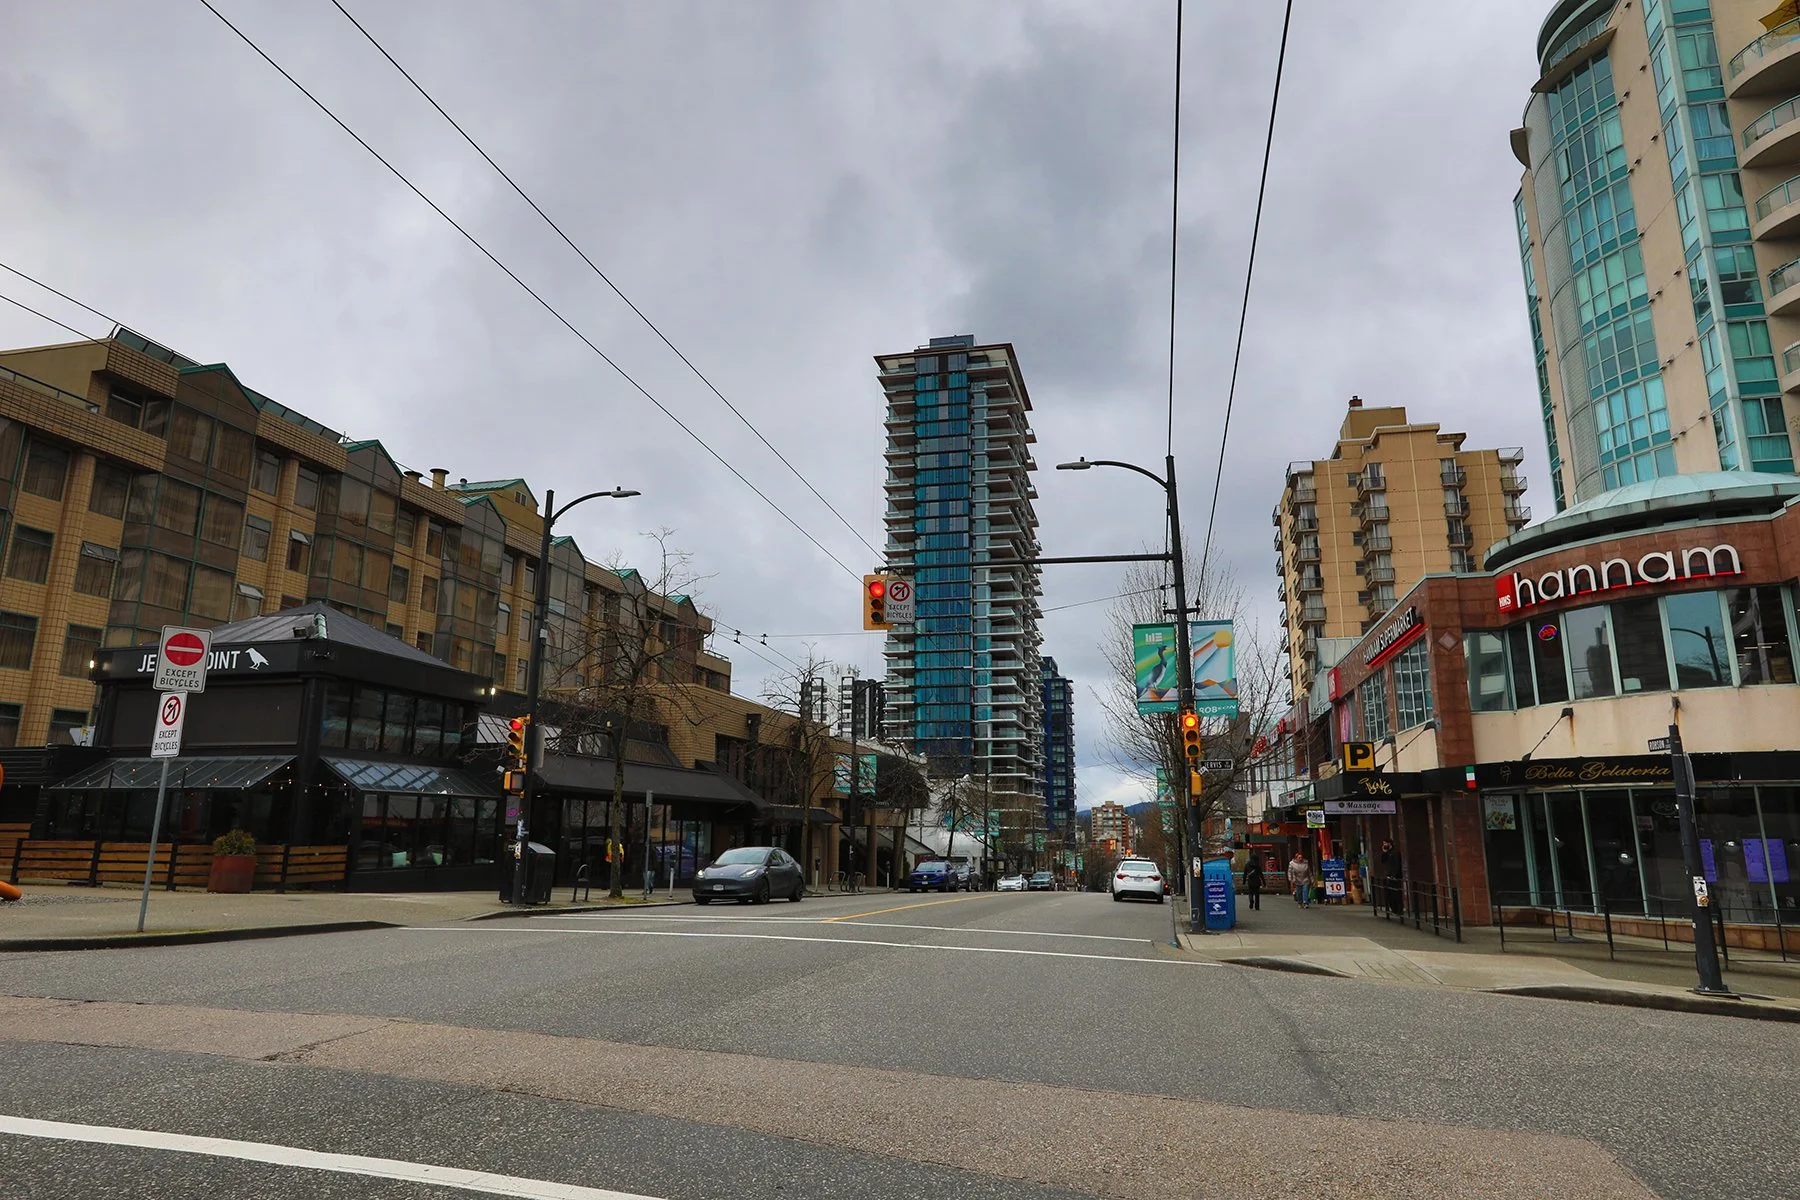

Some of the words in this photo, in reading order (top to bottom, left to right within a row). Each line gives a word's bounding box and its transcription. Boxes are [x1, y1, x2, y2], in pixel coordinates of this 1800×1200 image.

[1513, 544, 1742, 608] hannam
[887, 611, 913, 619] BICYCLES
[1379, 607, 1414, 651] SUPERMARKET
[206, 651, 240, 670] OINT
[165, 669, 197, 679] EXCEPT
[160, 678, 200, 688] BICYCLES
[159, 730, 178, 739] EXCEPT
[154, 741, 178, 752] BICYCLES
[1350, 744, 1370, 766] P
[1525, 764, 1575, 780] Bella
[1579, 761, 1672, 781] Gelateria
[1346, 801, 1381, 810] Massage
